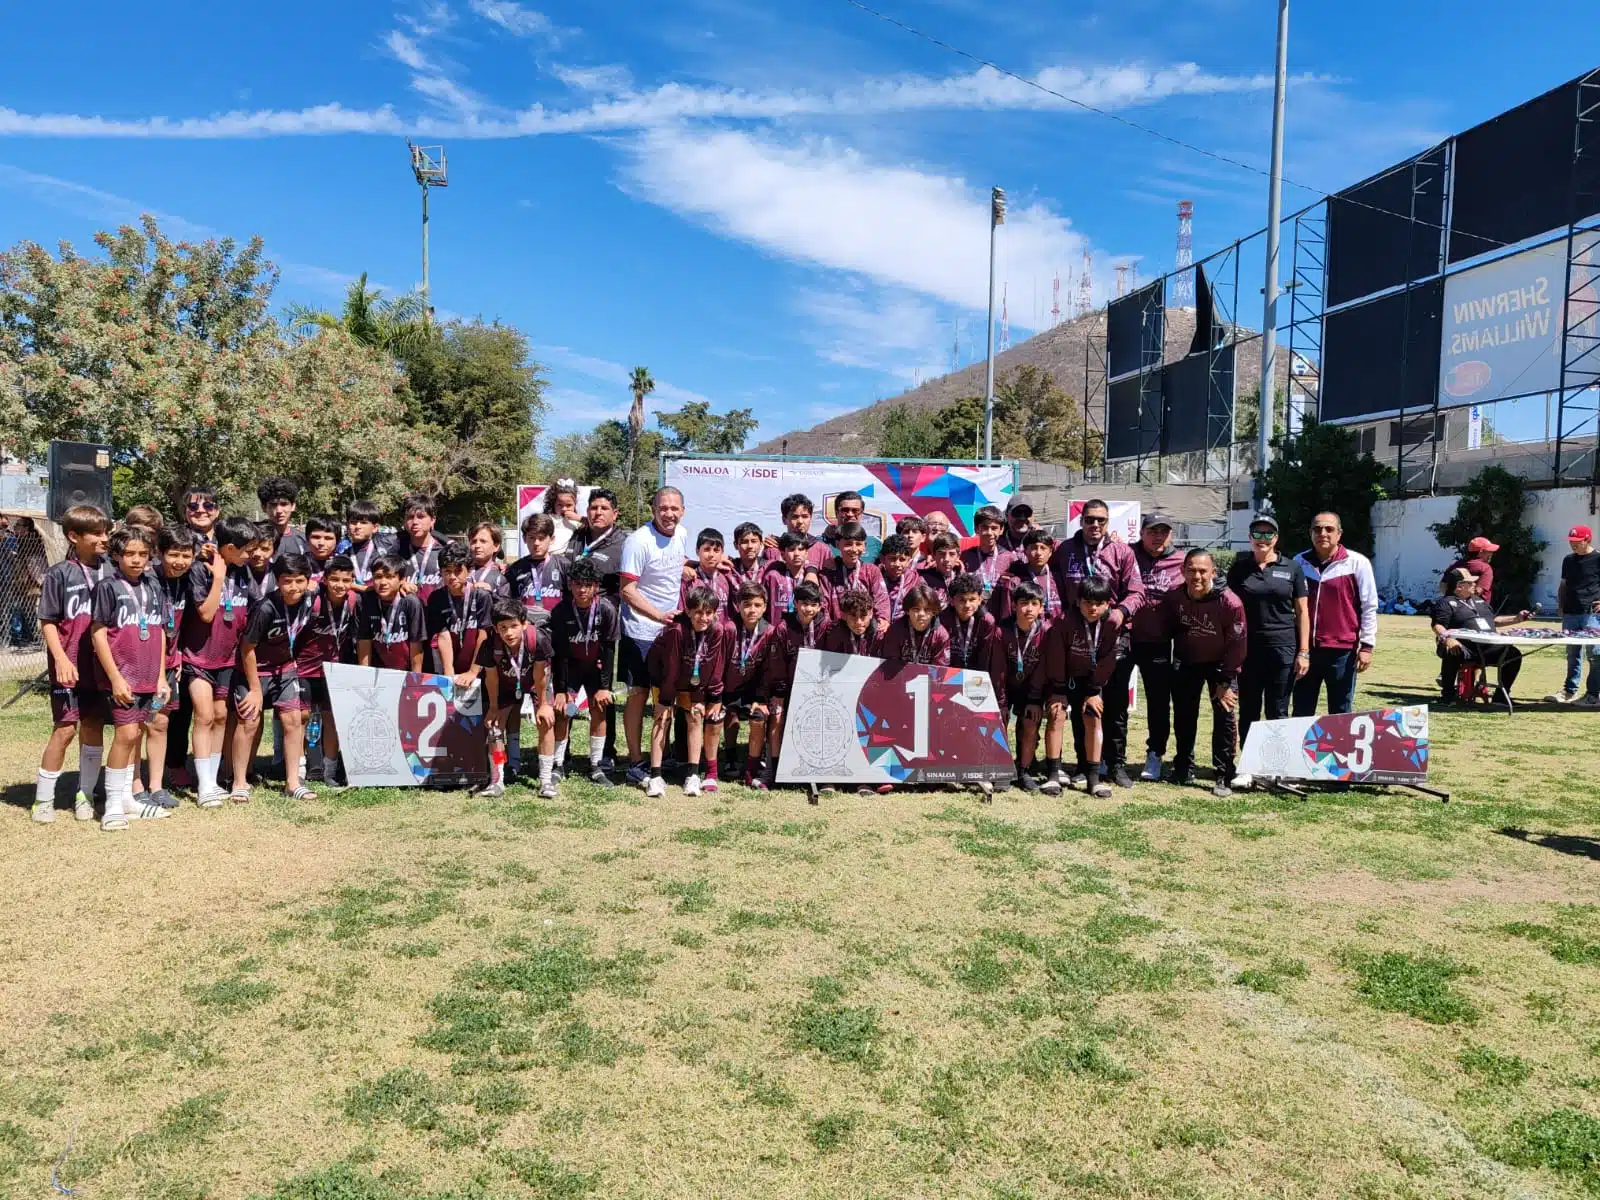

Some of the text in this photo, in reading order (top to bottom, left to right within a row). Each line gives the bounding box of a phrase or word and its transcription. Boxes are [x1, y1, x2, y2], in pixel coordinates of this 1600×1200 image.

[683, 465, 729, 475] SINALOA
[751, 468, 778, 478] ISDE
[417, 691, 447, 757] 2
[905, 675, 929, 759] 1
[1347, 714, 1375, 773] 3
